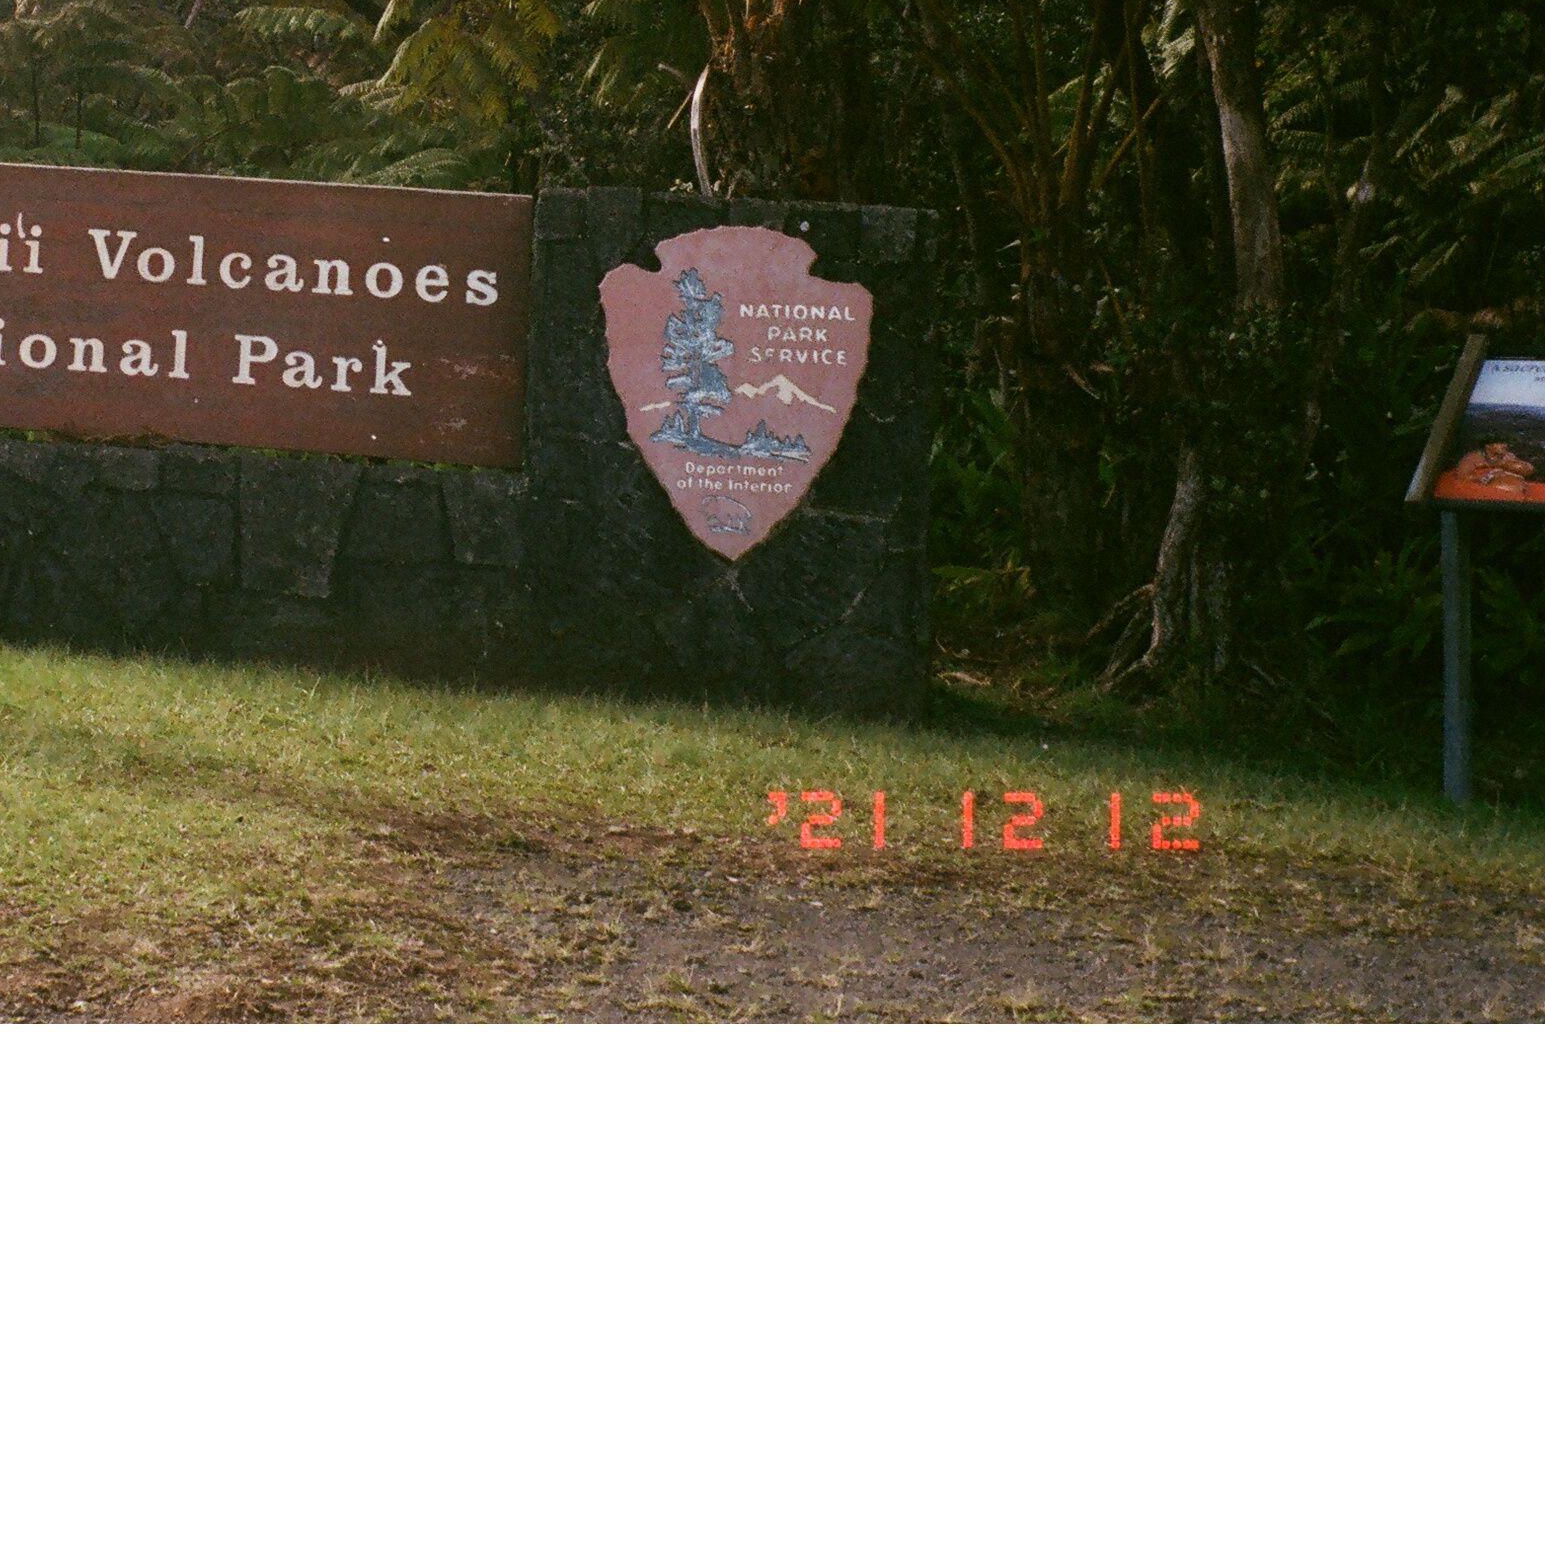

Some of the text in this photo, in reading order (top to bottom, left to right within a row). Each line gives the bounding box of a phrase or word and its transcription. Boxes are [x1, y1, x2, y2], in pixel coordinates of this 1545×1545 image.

[87, 228, 499, 306] Volcanoes
[739, 303, 855, 322] NATIONAL
[767, 326, 828, 343] PARK
[232, 332, 413, 397] Park
[749, 346, 848, 366] SERVICE
[685, 461, 784, 476] Department
[676, 477, 794, 493] of the Interior
